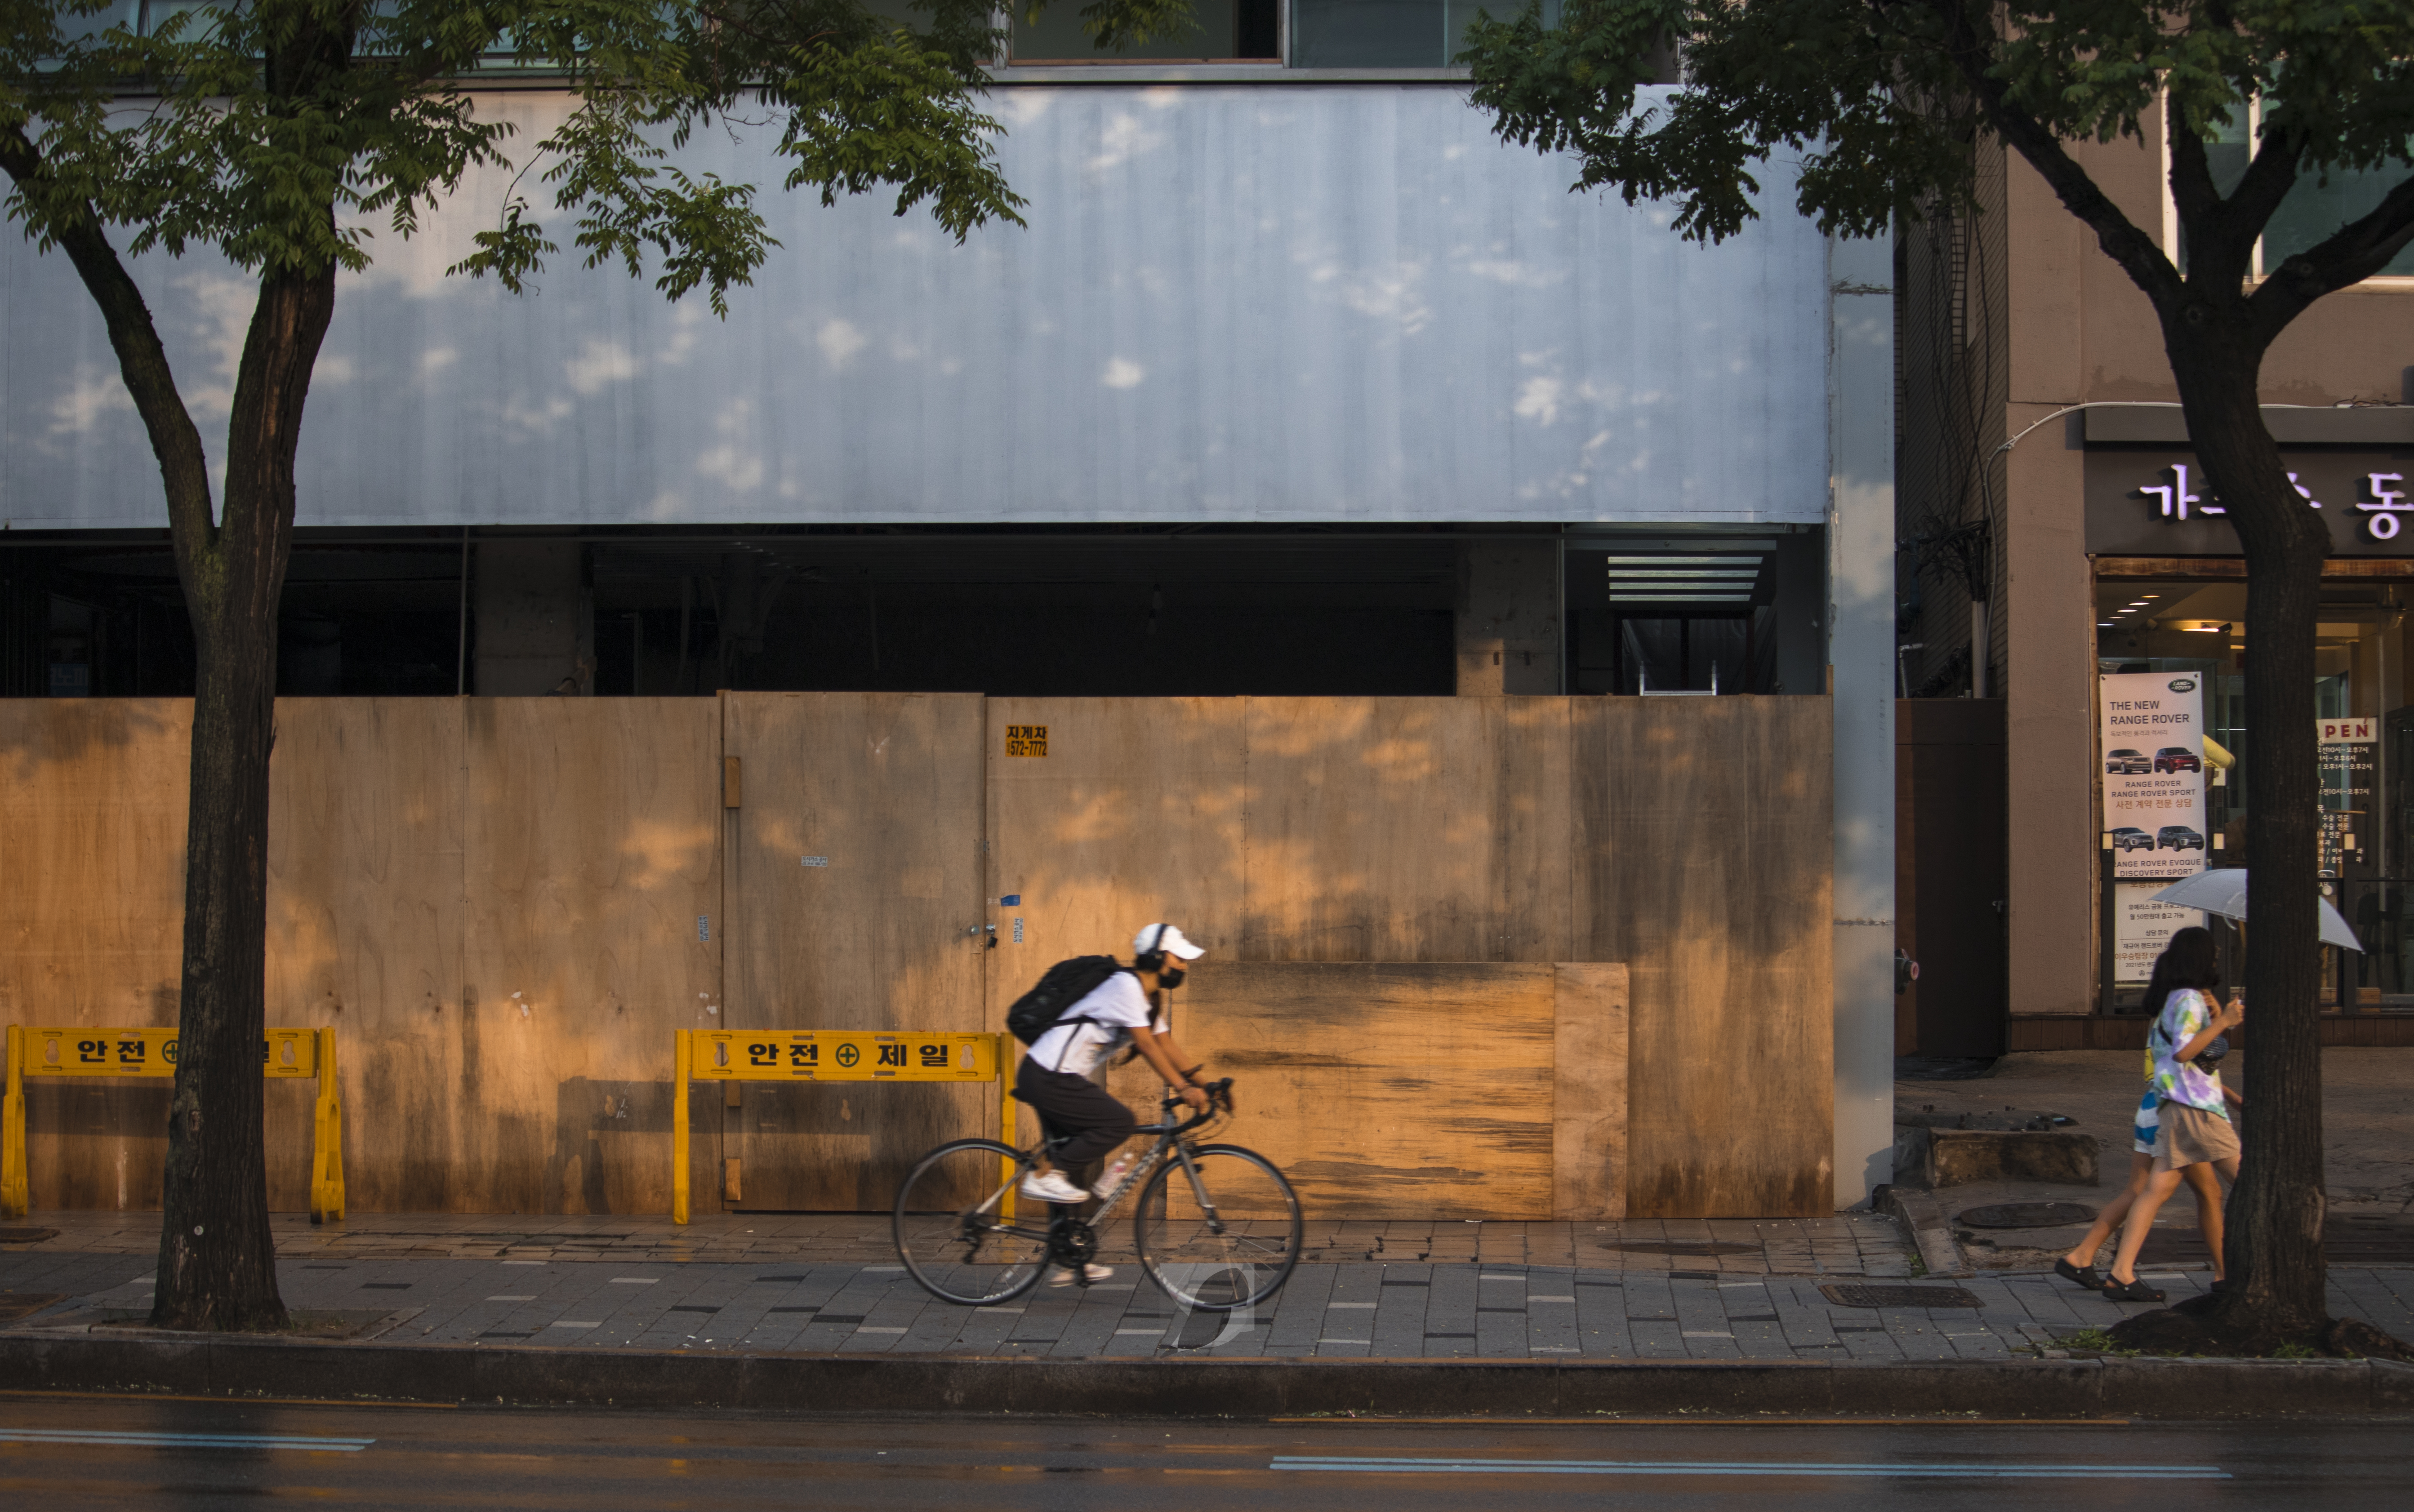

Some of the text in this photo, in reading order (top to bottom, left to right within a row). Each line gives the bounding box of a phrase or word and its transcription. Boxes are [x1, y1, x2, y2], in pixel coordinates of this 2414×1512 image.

[2110, 700, 2160, 710] THE NEW
[2111, 714, 2189, 725] RANGE ROVER
[1007, 726, 1047, 739] 지게차
[2325, 724, 2368, 738] PEN
[1011, 740, 1047, 756] 572-7772
[2116, 799, 2192, 809] 사전 계약 전문 상담
[2336, 814, 2350, 822] 전문
[2336, 823, 2350, 831] 전문
[2115, 952, 2147, 961] 이우승팀장
[77, 1040, 145, 1063] 안전
[748, 1043, 949, 1067] 안전 제일
